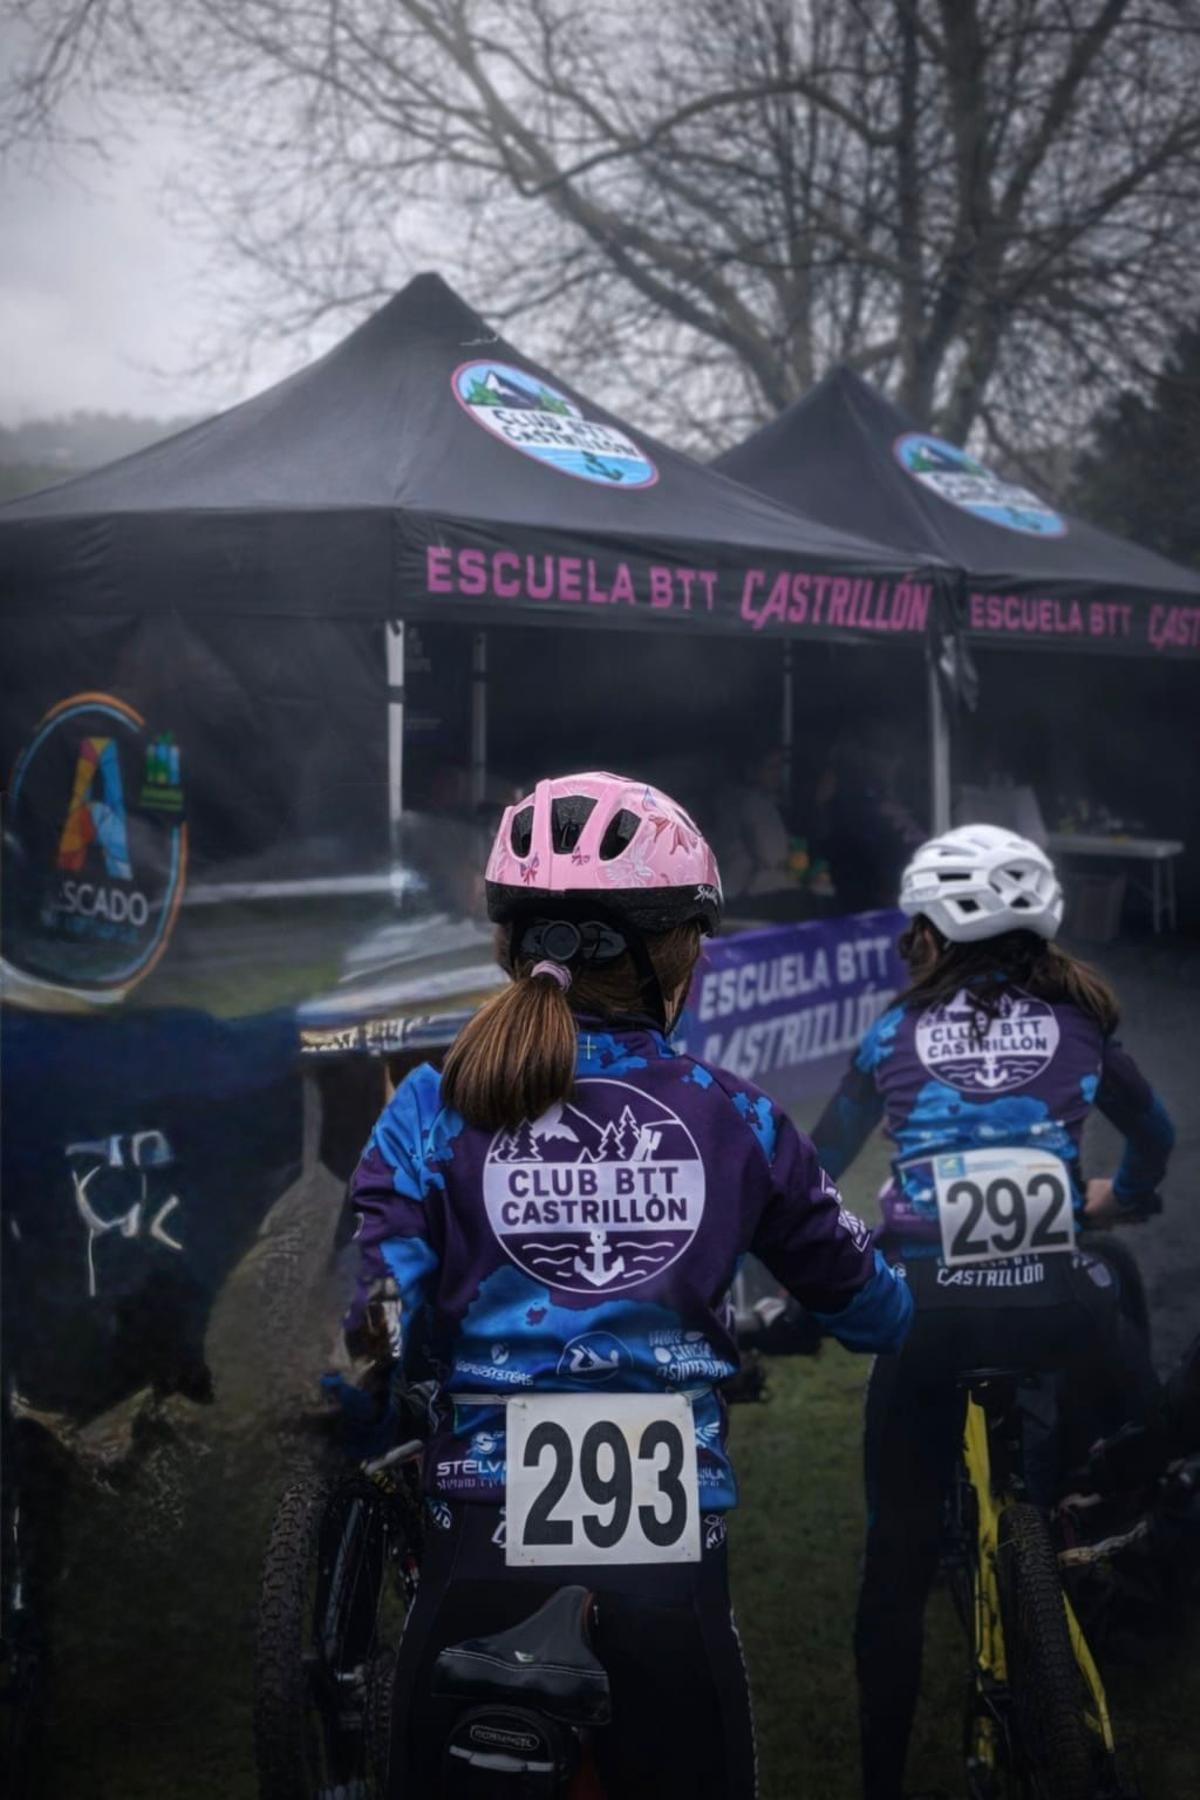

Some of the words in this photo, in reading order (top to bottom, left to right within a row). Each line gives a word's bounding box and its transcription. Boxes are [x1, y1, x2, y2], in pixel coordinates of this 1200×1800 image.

[427, 545, 637, 605] ESCUELA
[650, 566, 718, 611] BTT
[740, 568, 934, 630] CASTRILLÓN
[970, 593, 1083, 634] ESCUELA
[1089, 602, 1134, 637] BTT
[699, 946, 831, 1023] ESCUELA
[836, 936, 893, 984] BTT
[1001, 1020, 1041, 1037] BTT
[508, 1168, 598, 1198] CLUB
[616, 1166, 679, 1195] BTT
[501, 1192, 687, 1226] CASTRILLÓN
[946, 1172, 1070, 1257] 292
[437, 1460, 507, 1476] STELV
[522, 1420, 687, 1549] 293
